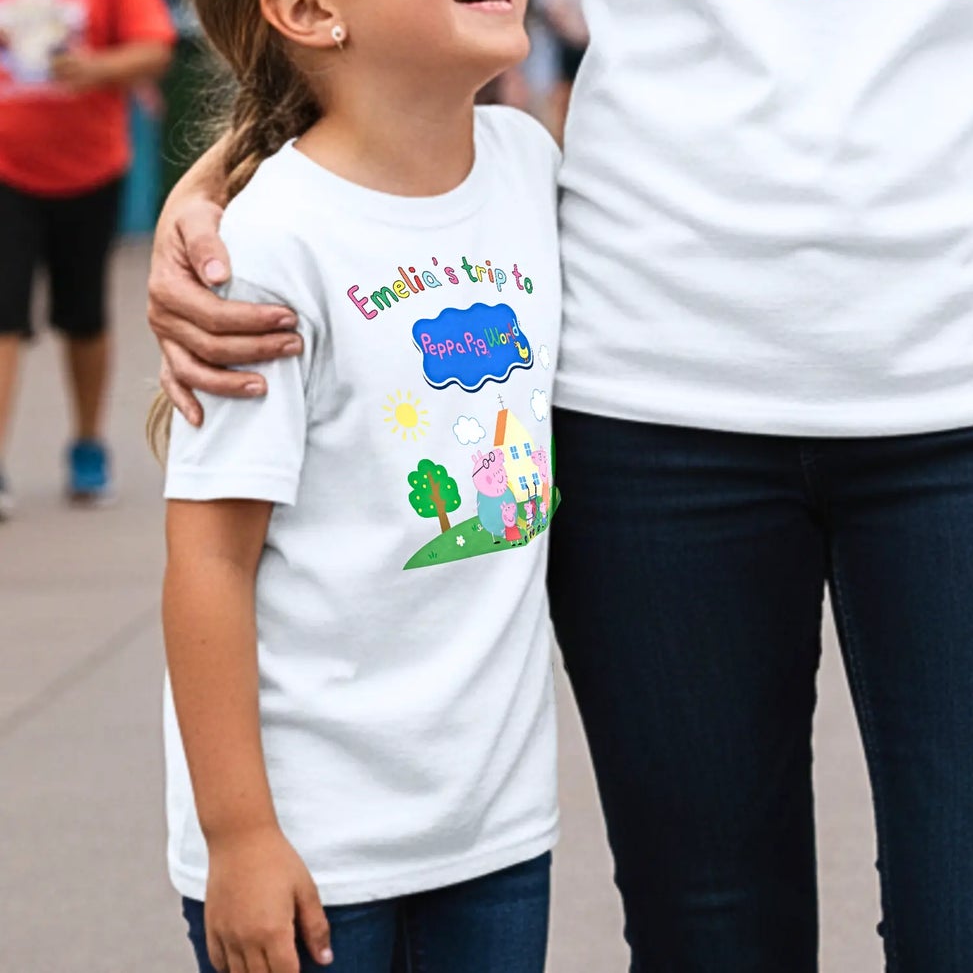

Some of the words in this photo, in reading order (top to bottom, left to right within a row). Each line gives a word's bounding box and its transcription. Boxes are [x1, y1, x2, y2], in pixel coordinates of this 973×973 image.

[346, 256, 460, 320] Emelia's
[461, 256, 507, 292] trip
[512, 263, 534, 294] to
[420, 332, 466, 360] Peppa
[463, 331, 488, 357] Pig
[484, 318, 520, 347] World
